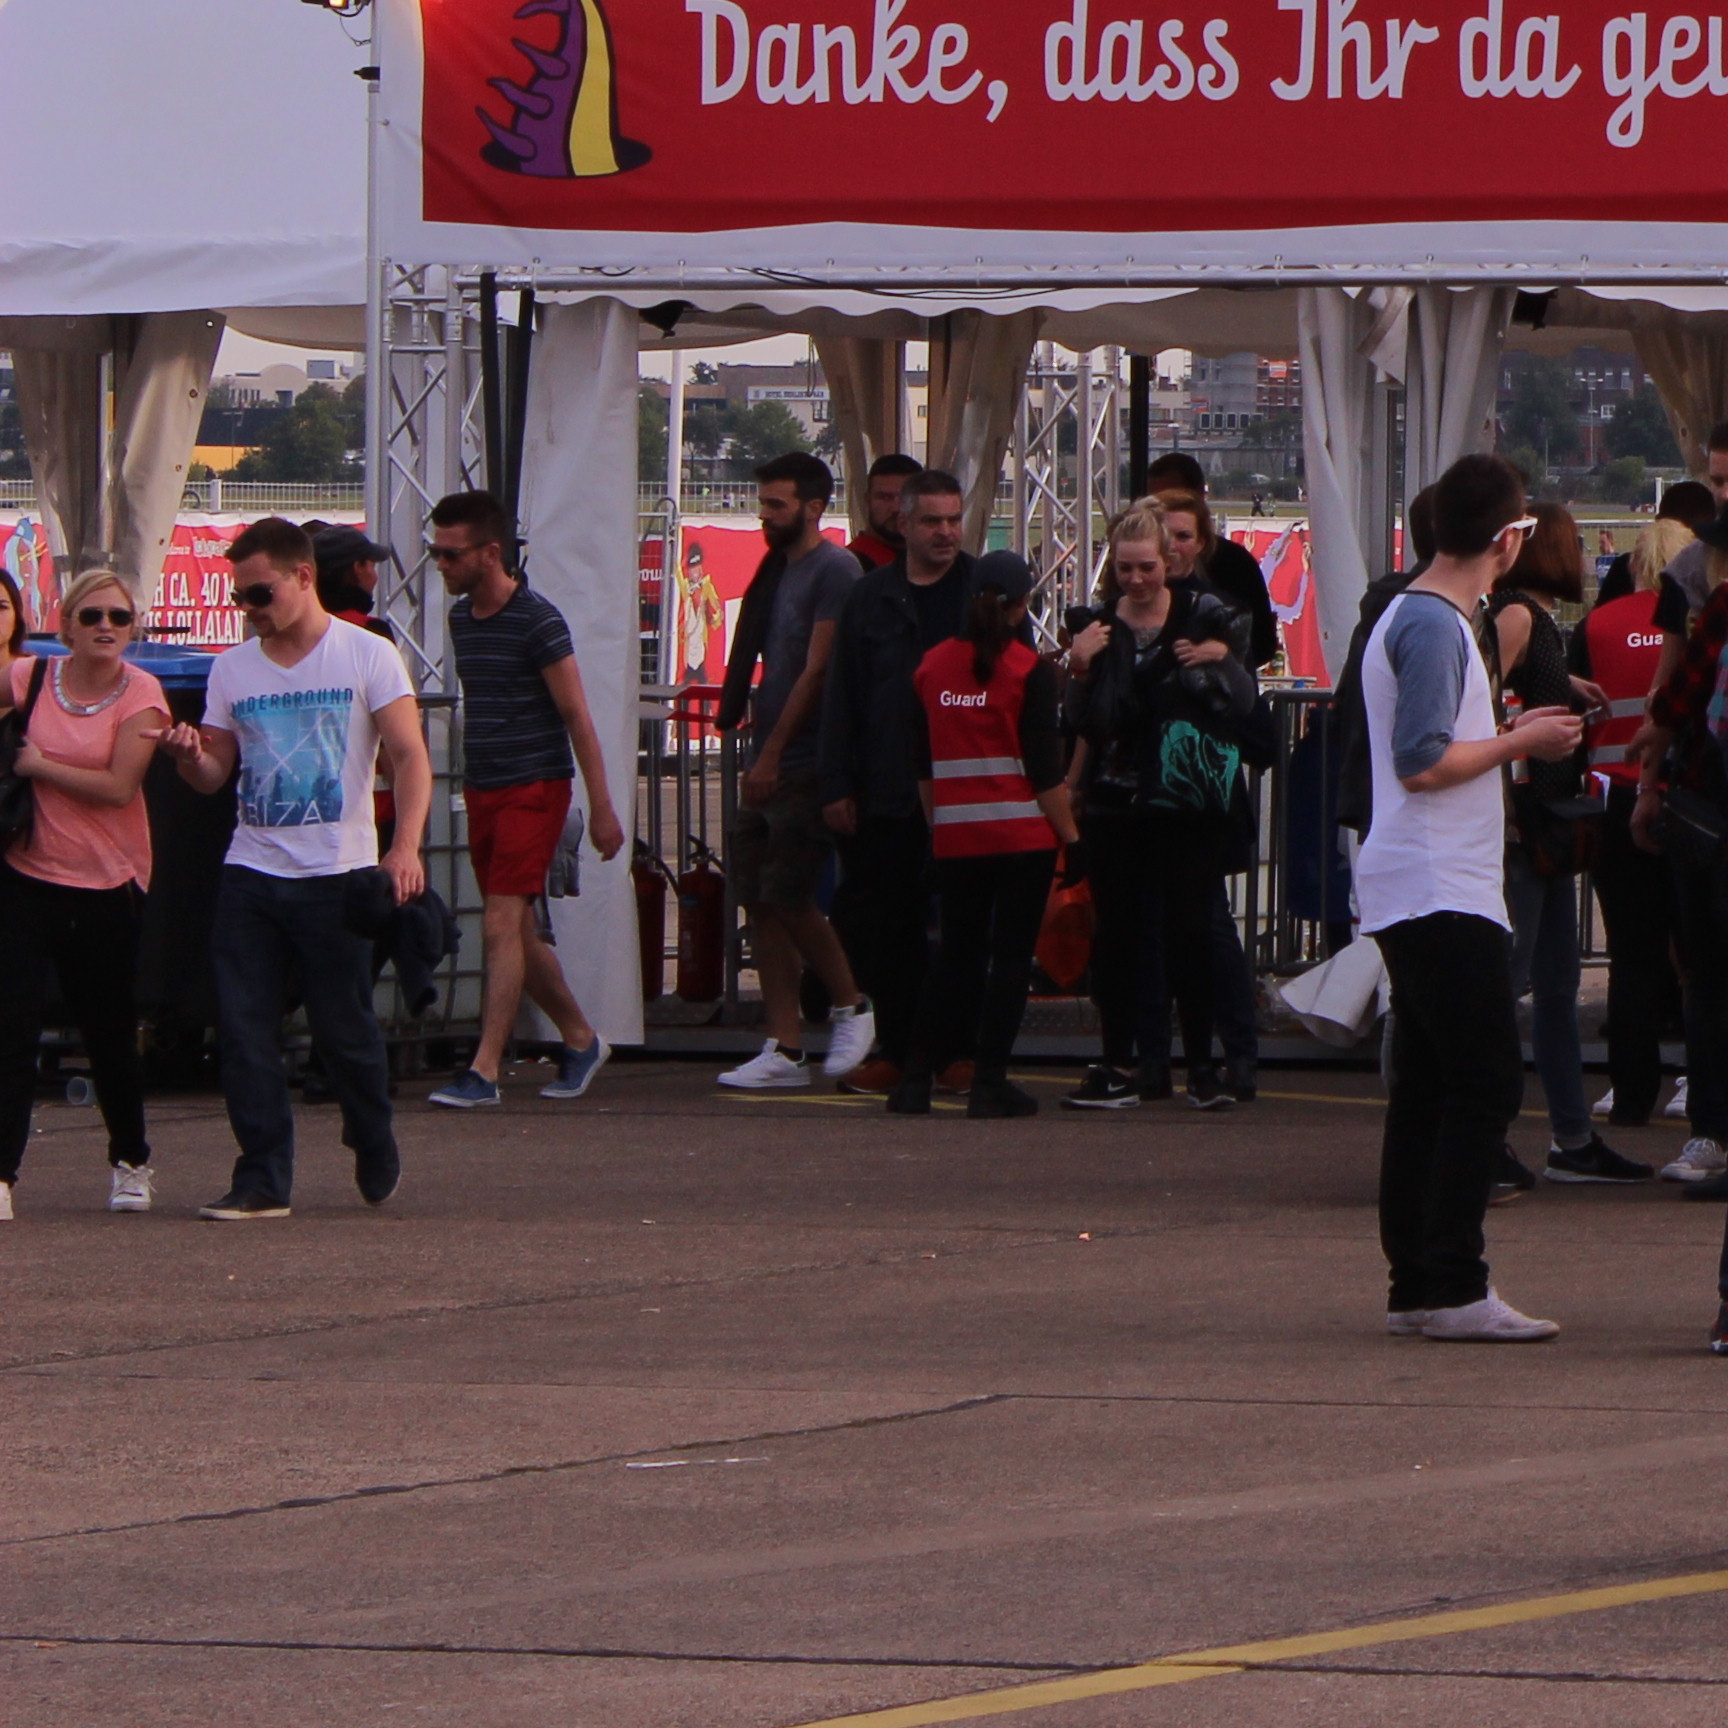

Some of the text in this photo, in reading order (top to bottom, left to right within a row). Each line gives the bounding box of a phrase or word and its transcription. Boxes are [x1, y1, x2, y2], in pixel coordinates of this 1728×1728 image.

[170, 573, 196, 607] CA.
[201, 573, 220, 607] 40
[1627, 632, 1664, 648] Gua
[940, 690, 987, 707] Guard
